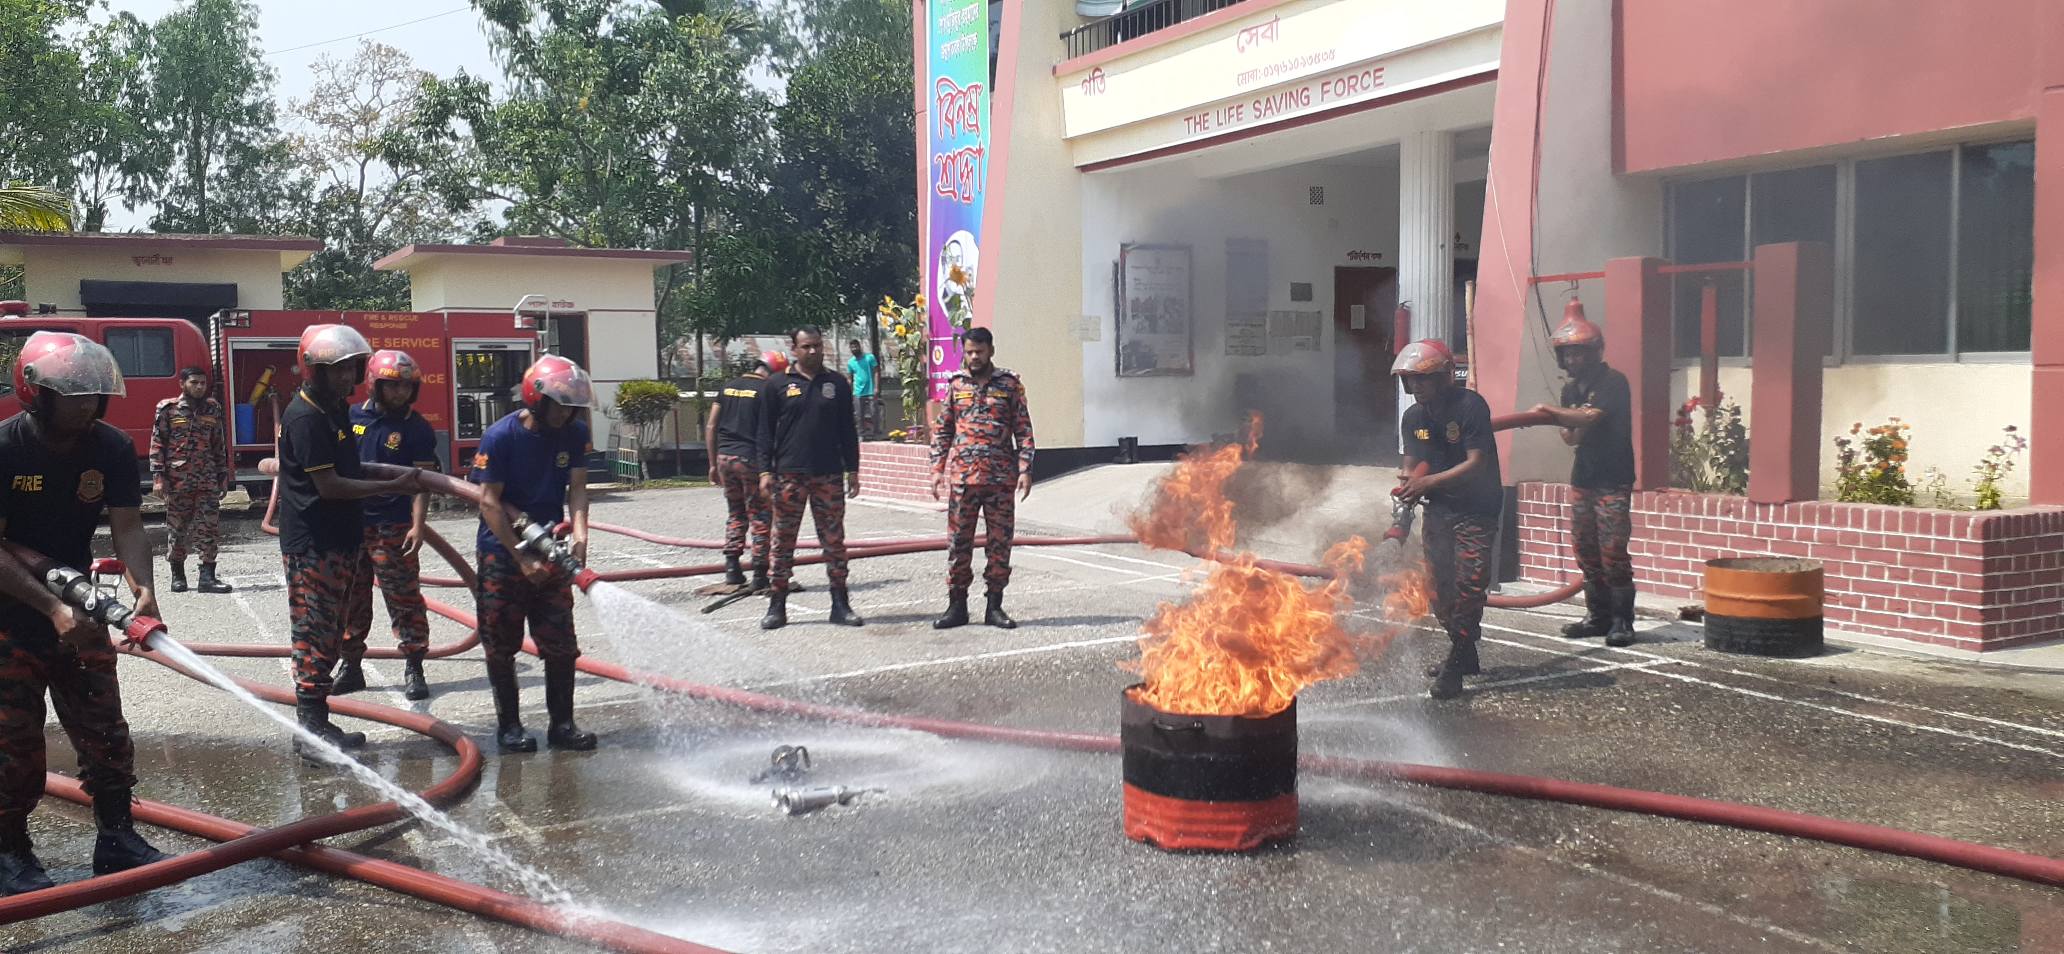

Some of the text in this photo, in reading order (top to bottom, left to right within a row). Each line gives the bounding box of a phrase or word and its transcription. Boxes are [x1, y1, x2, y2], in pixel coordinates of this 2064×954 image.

[1236, 13, 1281, 54] সেবা
[936, 78, 983, 138] বিনম্র
[1184, 67, 1385, 135] THE LIFE SAVING FORCE
[935, 140, 984, 202] শ্রদ্ধা
[384, 338, 440, 348] SERVICE
[12, 475, 43, 492] FIRE
